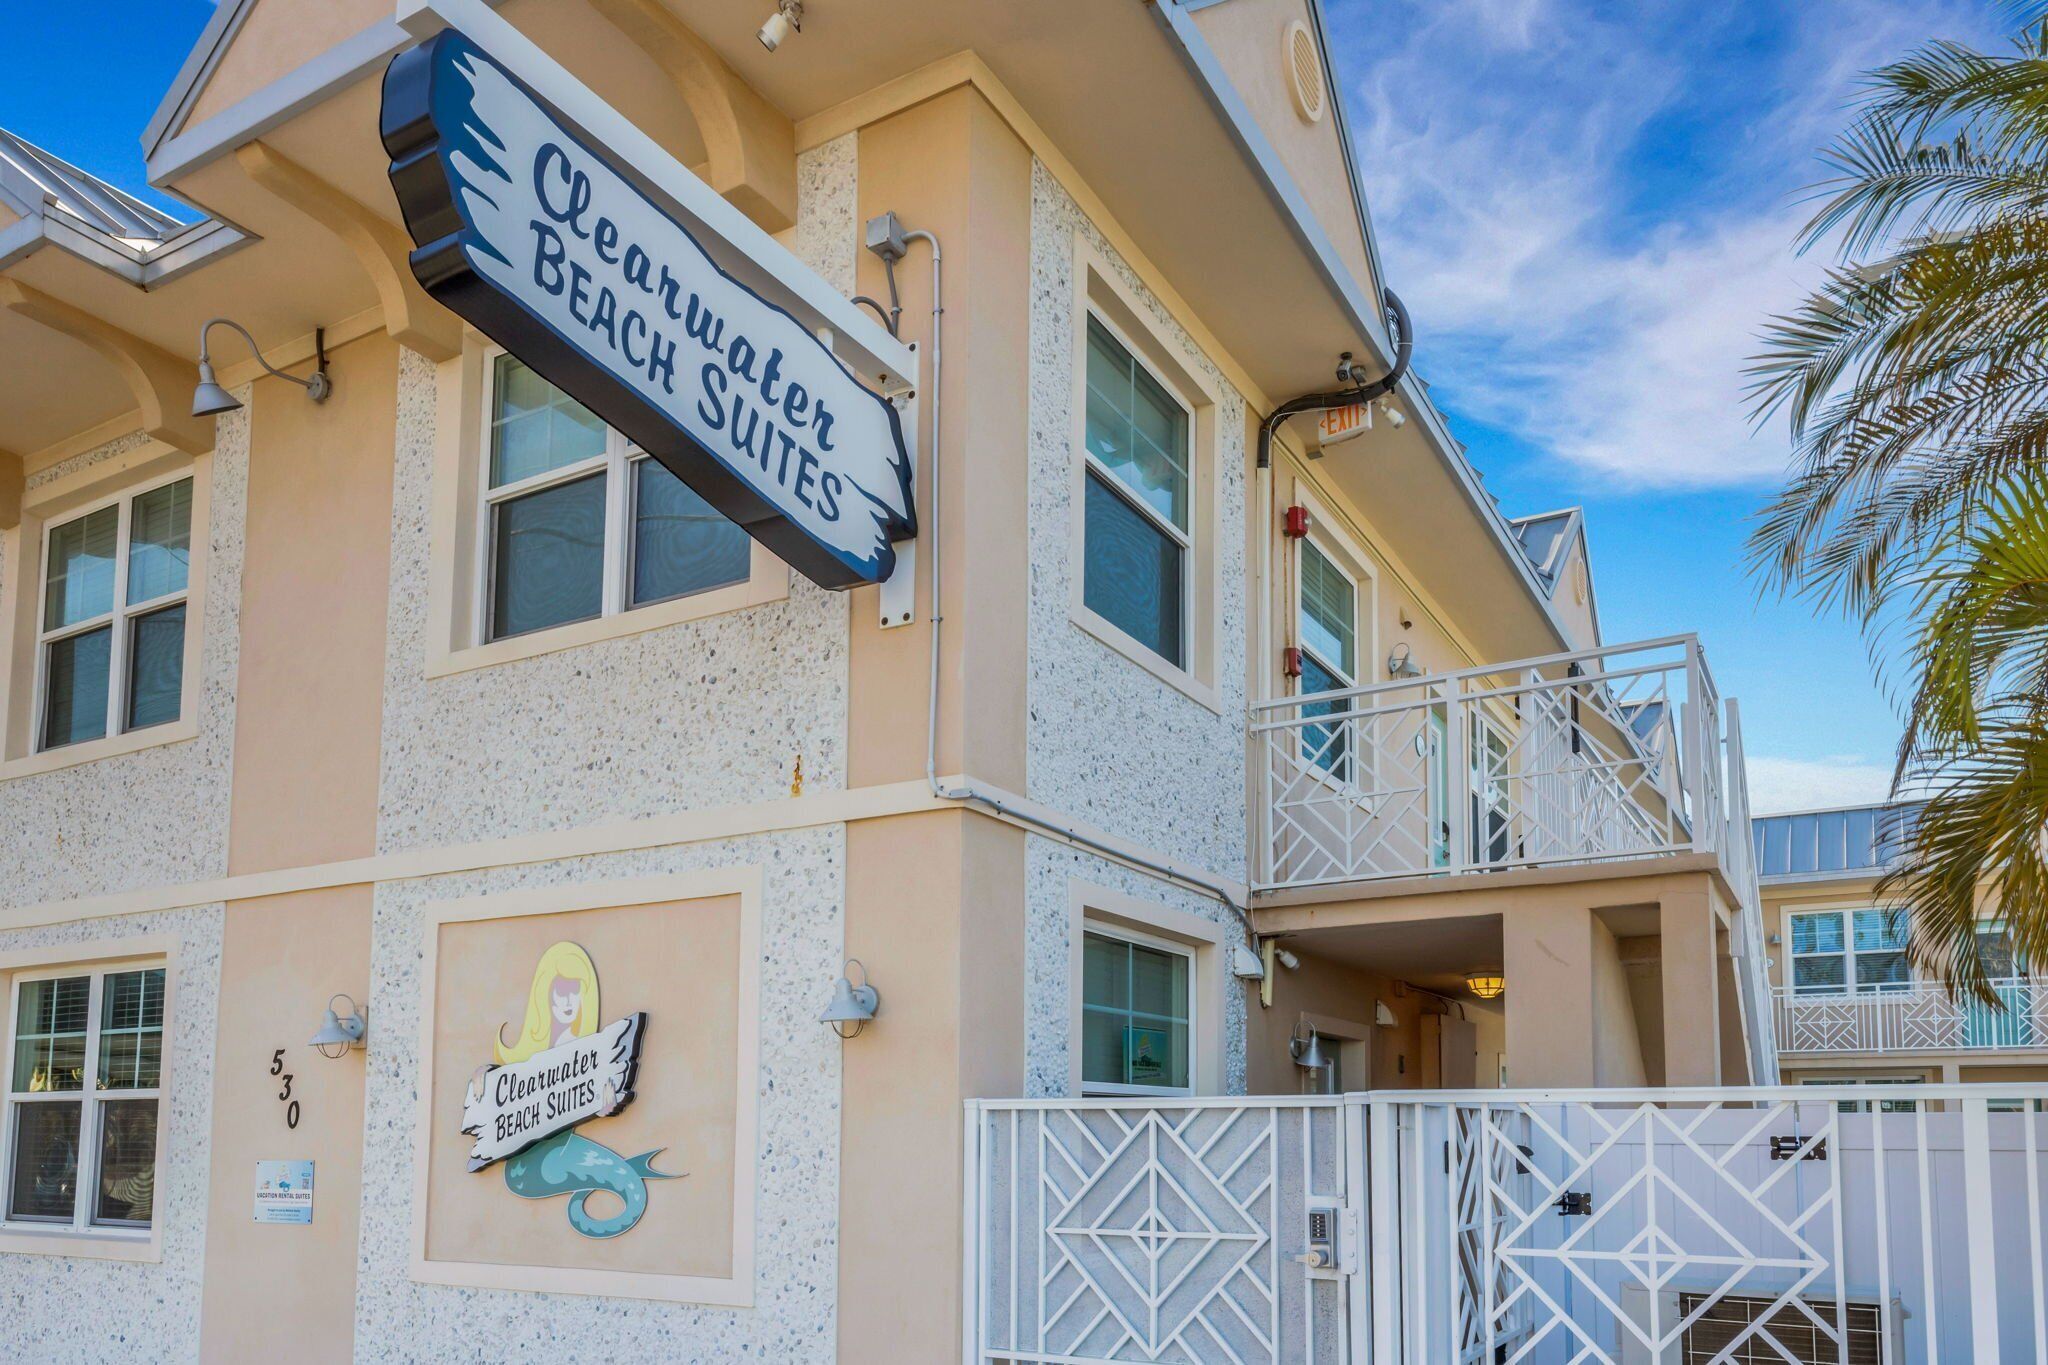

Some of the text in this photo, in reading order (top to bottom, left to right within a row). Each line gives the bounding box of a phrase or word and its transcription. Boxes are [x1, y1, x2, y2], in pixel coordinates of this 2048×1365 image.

[533, 142, 836, 452] Clearwater
[529, 219, 843, 523] BEACH SUITES
[1326, 404, 1360, 435] EXIT
[495, 1078, 595, 1142] BEACH SUITES
[496, 1050, 598, 1107] Clearwater
